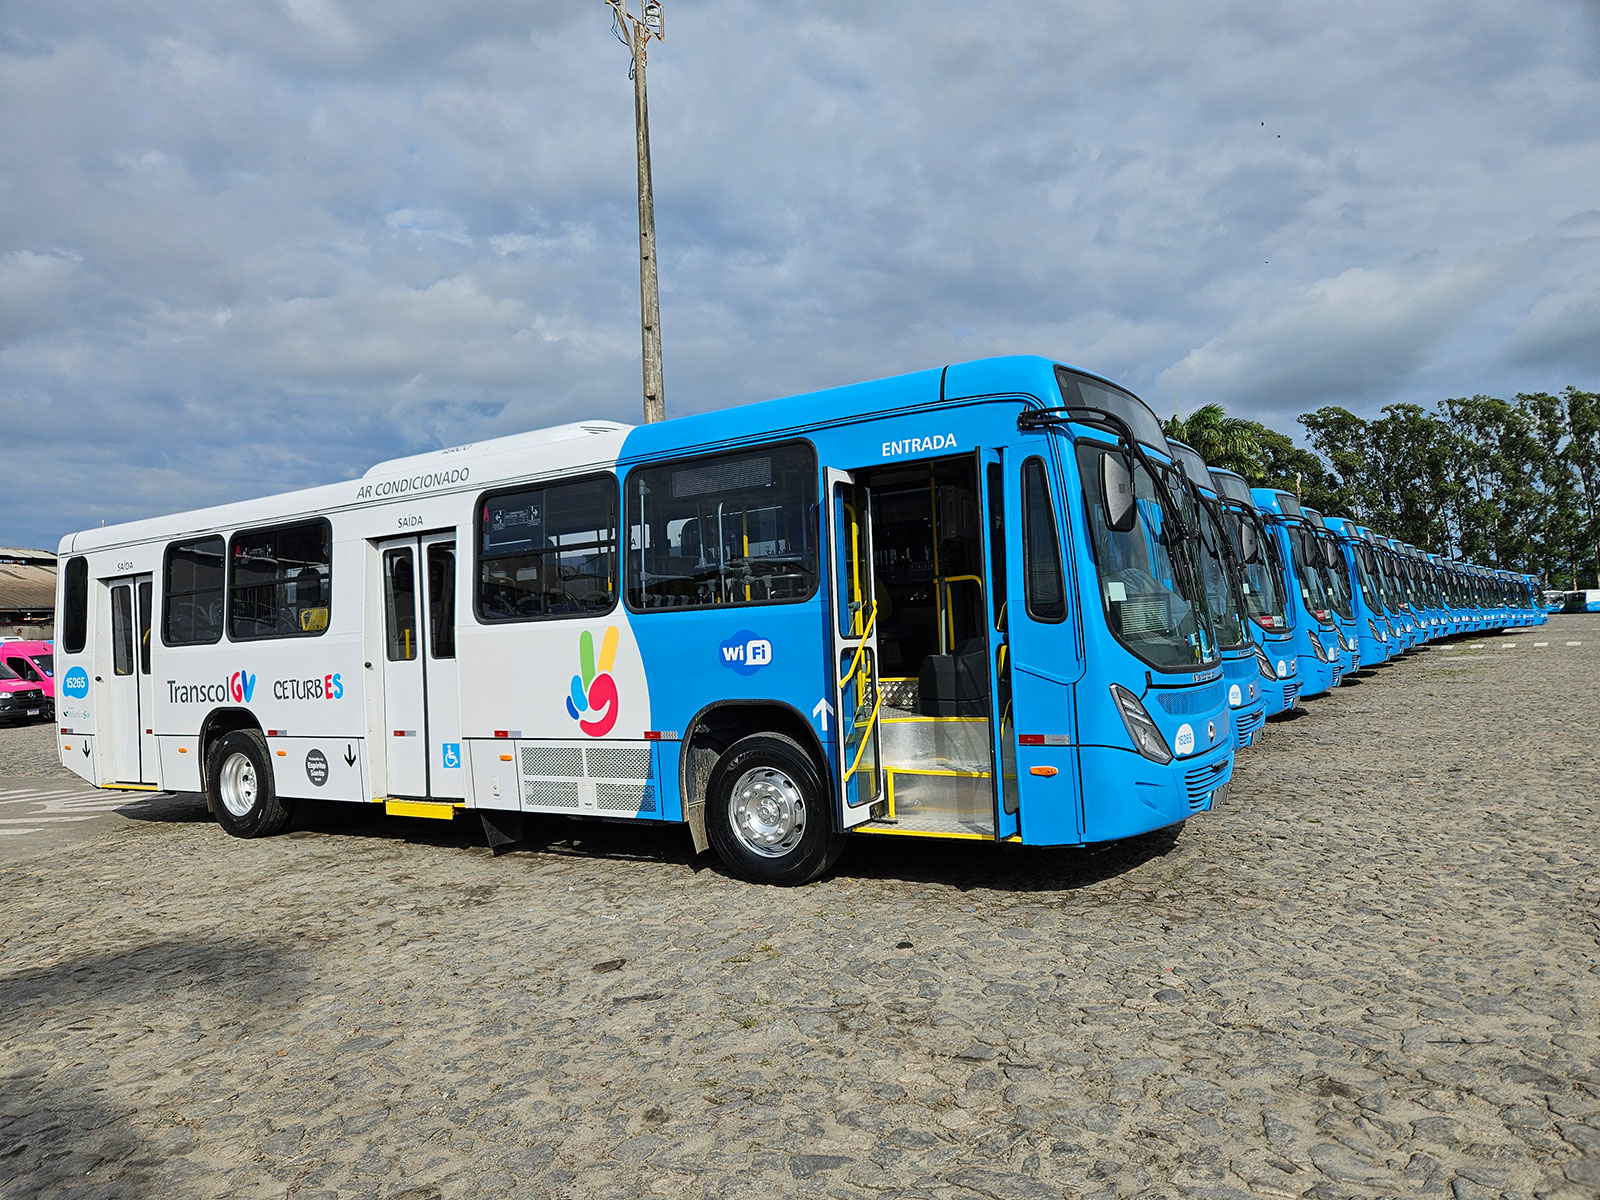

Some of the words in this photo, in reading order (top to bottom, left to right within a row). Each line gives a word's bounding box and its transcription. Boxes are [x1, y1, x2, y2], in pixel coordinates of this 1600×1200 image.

[882, 433, 957, 457] ENTRADA
[356, 485, 372, 499] AR
[375, 467, 470, 496] CONDICIONADO
[397, 514, 423, 528] SAÍDA
[66, 677, 85, 688] 15265
